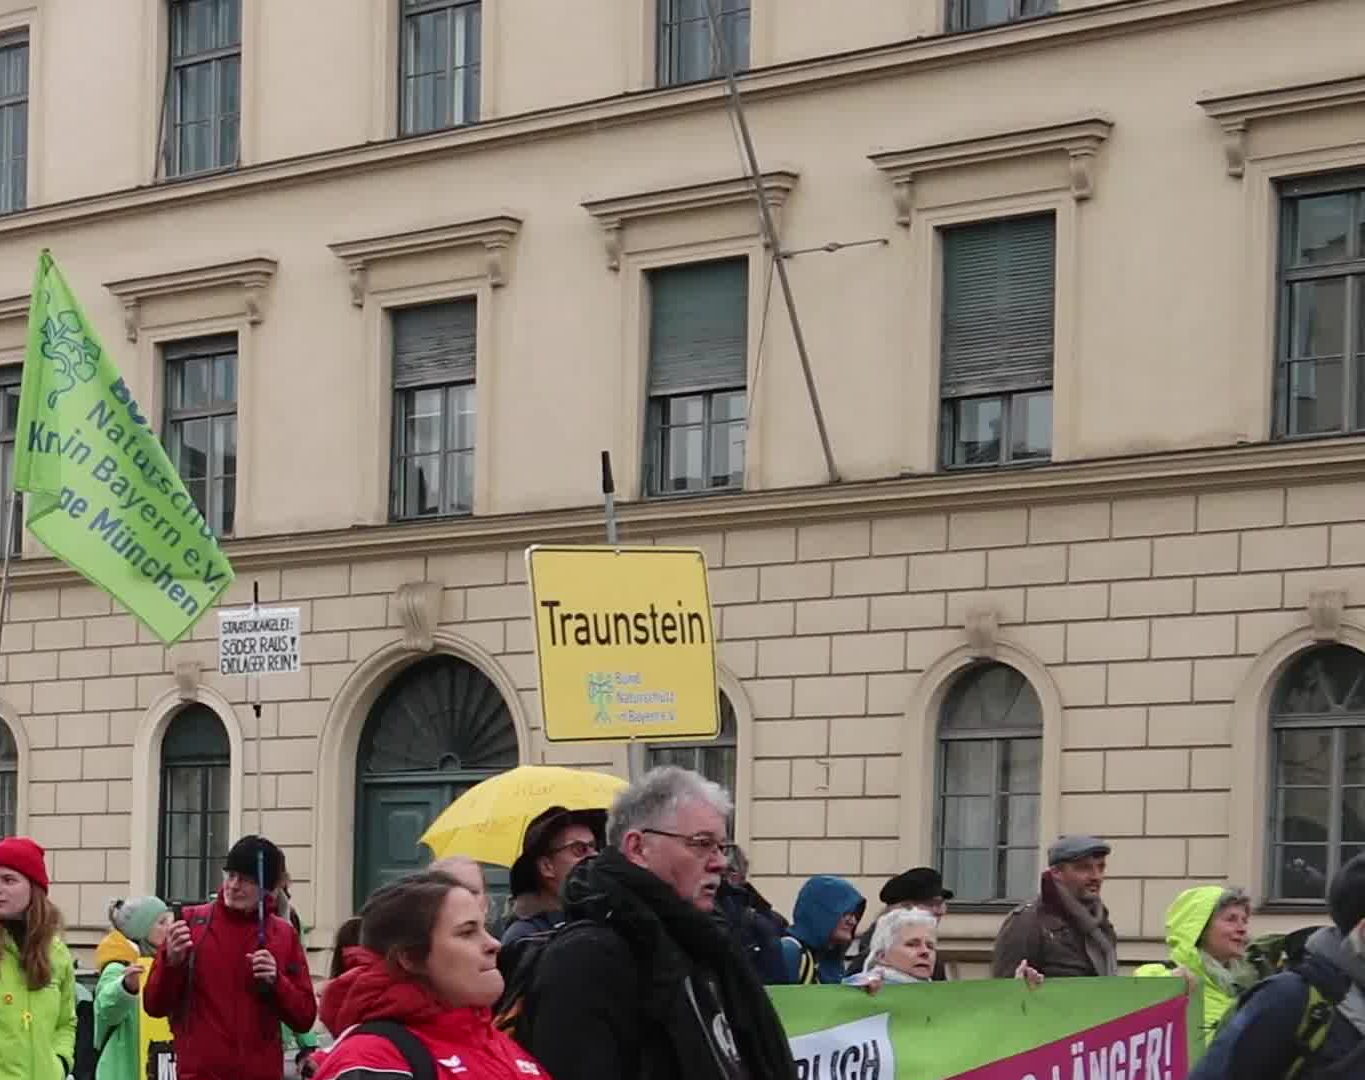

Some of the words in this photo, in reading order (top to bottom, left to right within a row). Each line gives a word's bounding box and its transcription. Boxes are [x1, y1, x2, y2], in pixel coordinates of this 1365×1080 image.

[89, 507, 199, 617] München
[91, 456, 182, 547] Bayern
[183, 548, 226, 592] e.V.
[541, 600, 705, 646] Traunstein
